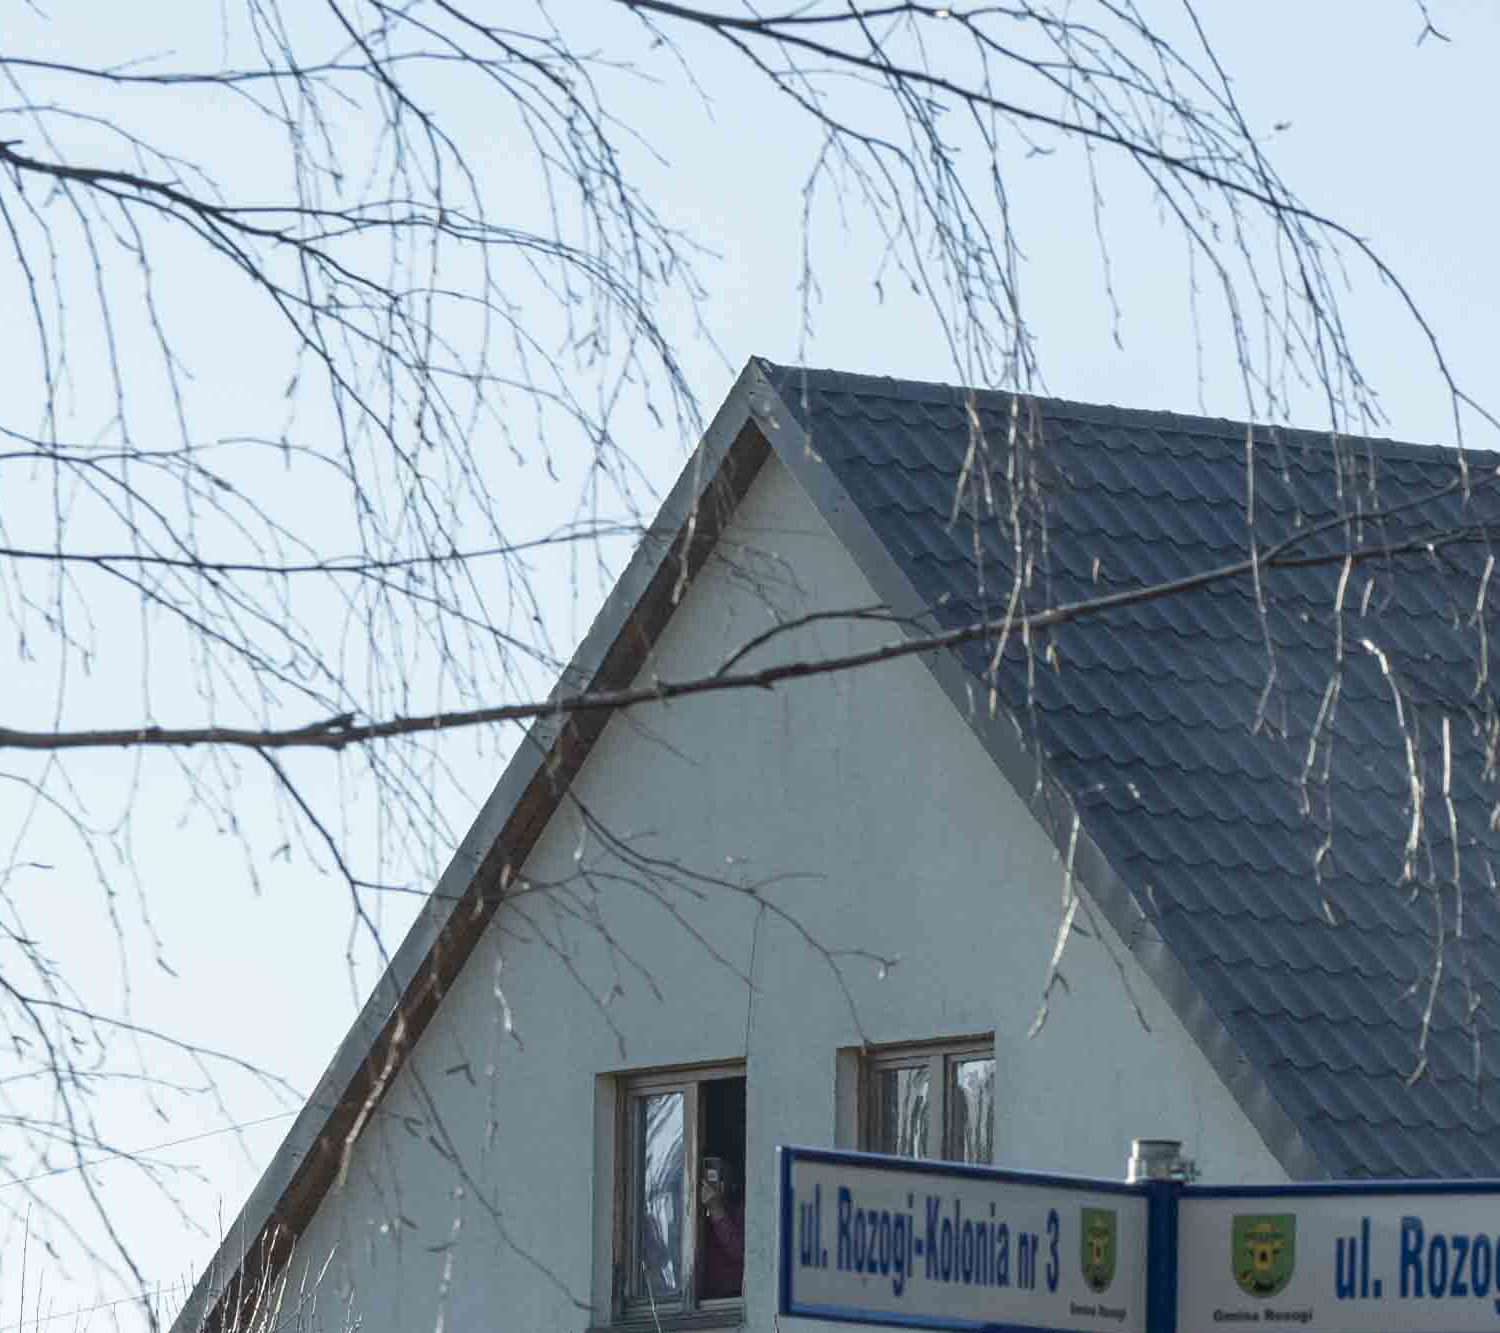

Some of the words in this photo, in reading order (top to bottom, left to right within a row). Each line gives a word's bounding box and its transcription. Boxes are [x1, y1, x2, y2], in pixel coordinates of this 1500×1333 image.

[800, 1183, 828, 1268] ul.
[836, 1185, 1011, 1297] Rozogi-Kolonia
[1017, 1230, 1040, 1290] nr
[1046, 1207, 1060, 1293] 3
[1335, 1215, 1382, 1299] ul.
[1264, 1307, 1314, 1324] Rozogi
